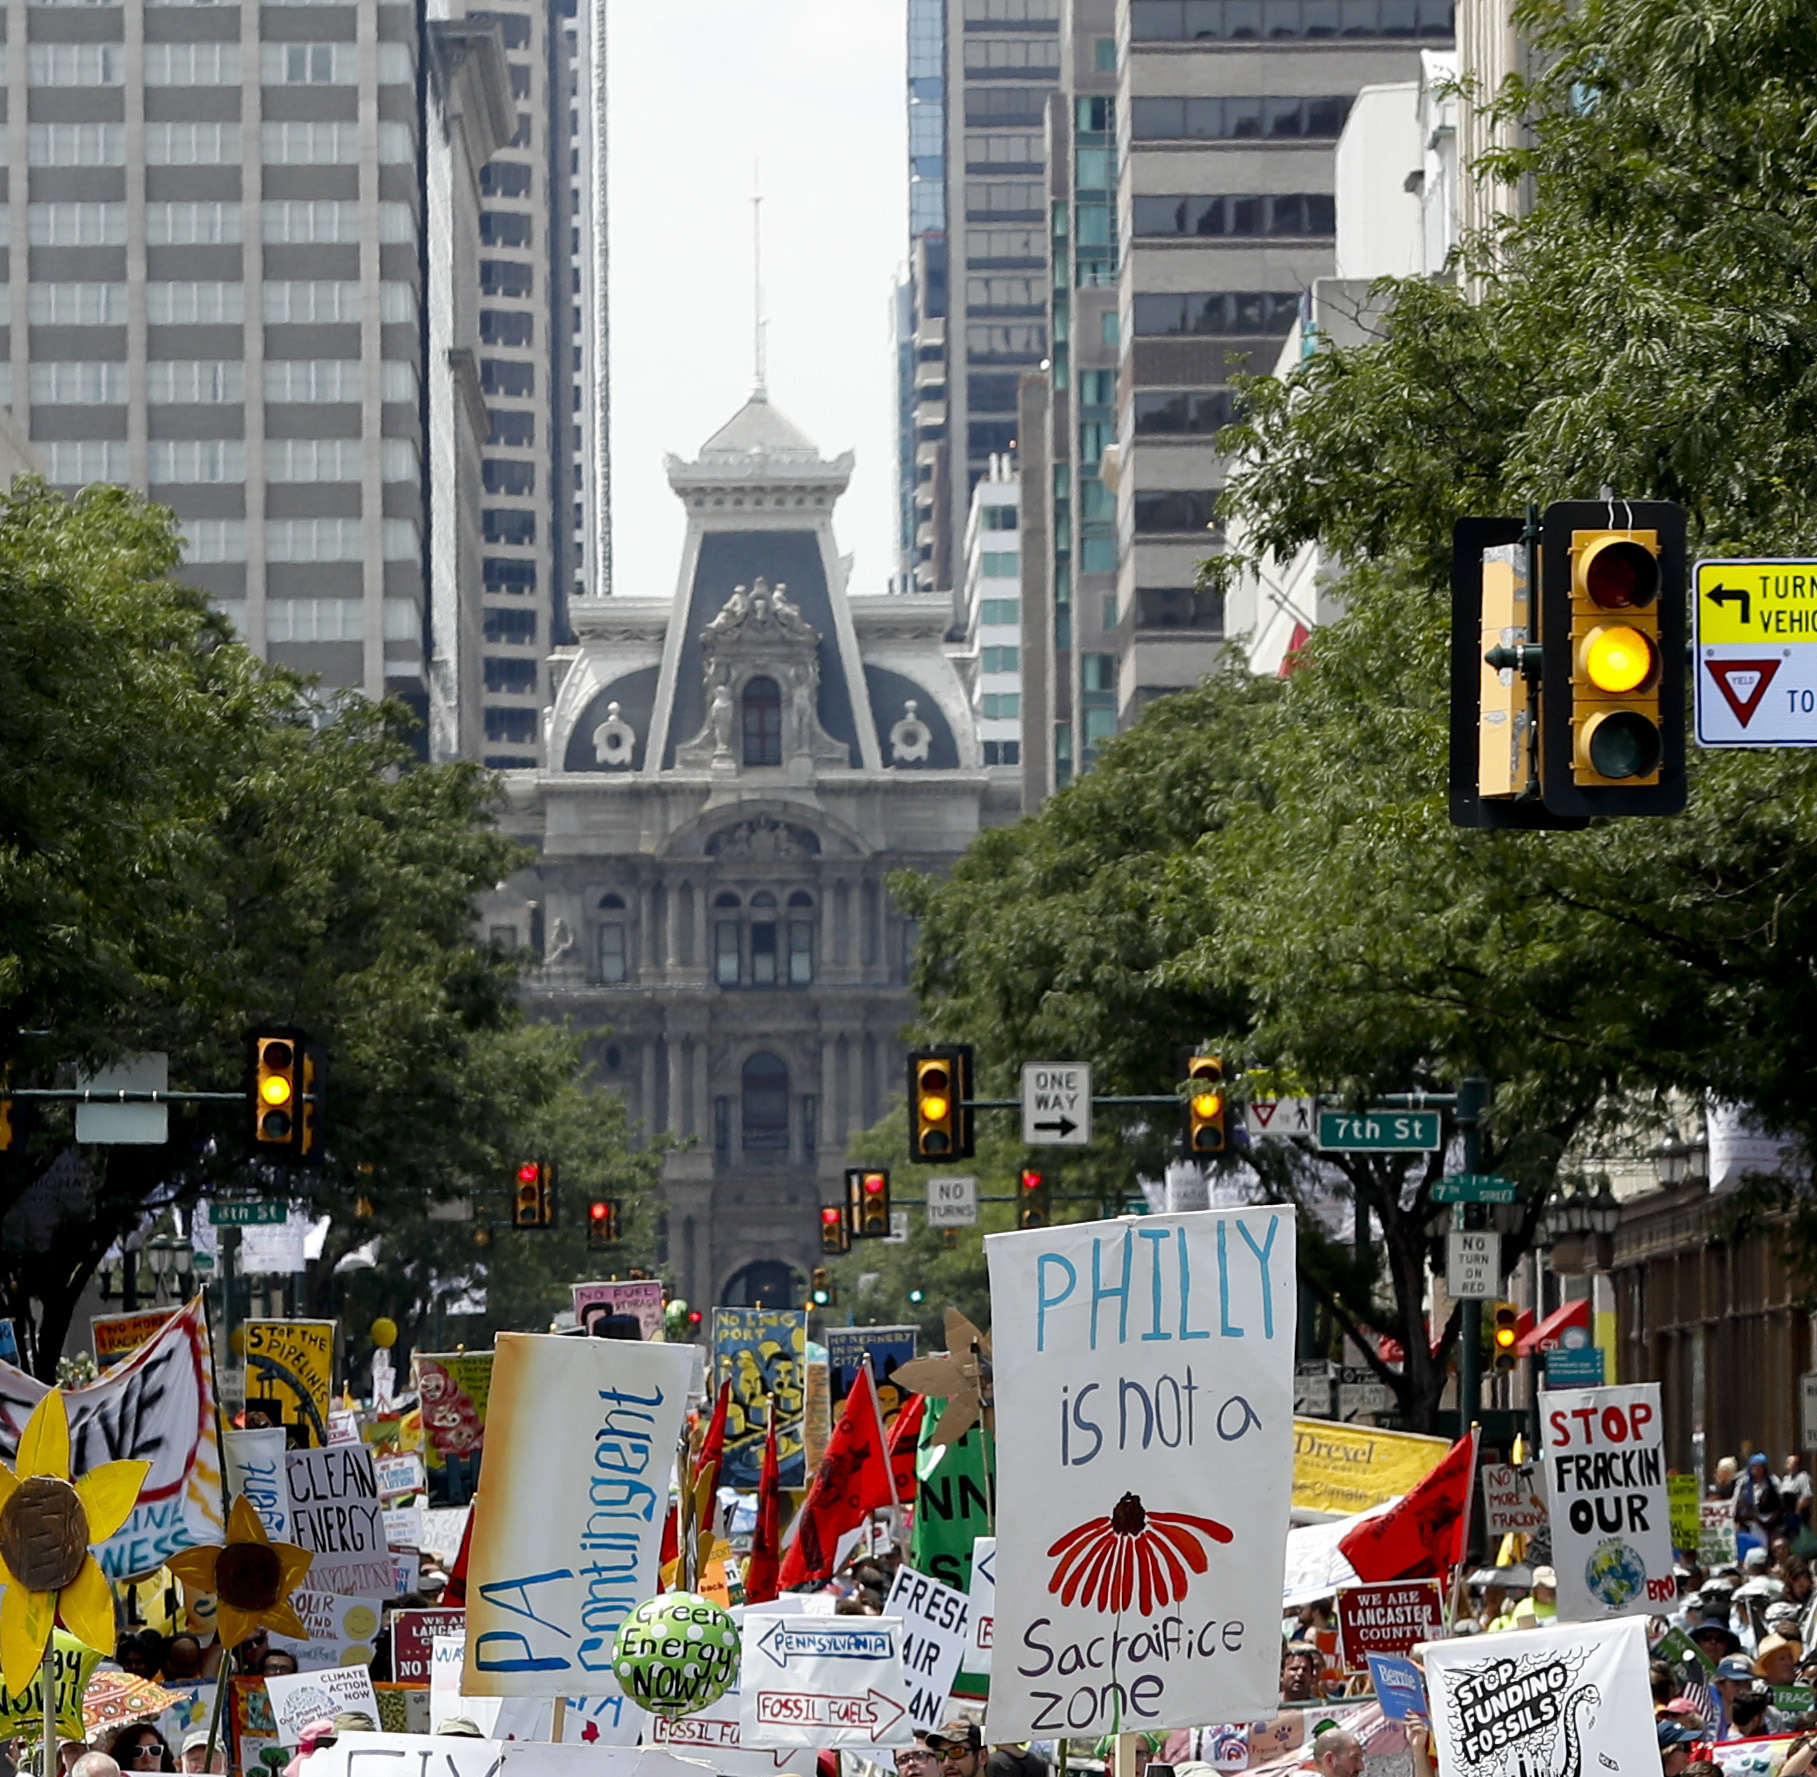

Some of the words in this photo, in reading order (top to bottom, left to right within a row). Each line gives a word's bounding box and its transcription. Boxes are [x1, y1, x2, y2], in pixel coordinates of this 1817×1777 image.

[1732, 676, 1755, 685] YIELD
[1787, 690, 1814, 712] TO
[1036, 1071, 1077, 1091] ONE
[1035, 1093, 1079, 1112] WAY
[1334, 1118, 1385, 1140] 7th
[1394, 1118, 1422, 1140] St
[939, 1184, 964, 1200] NO
[1458, 1254, 1489, 1266] TURN
[1036, 1214, 1279, 1352] PHILLY
[1465, 1268, 1482, 1279] ON
[1462, 1281, 1484, 1293] RED
[746, 1312, 796, 1327] LNG
[250, 1326, 294, 1348] STOP
[300, 1330, 327, 1352] THE
[719, 1329, 767, 1341] PORT
[268, 1339, 328, 1403] PIPELINES
[1119, 1365, 1199, 1450] not
[1216, 1395, 1262, 1440] a
[1550, 1403, 1652, 1447] STOP
[288, 1450, 377, 1502] CLEAN
[1489, 1493, 1523, 1506] MORE
[1492, 1511, 1548, 1526] FRACKING
[1569, 1494, 1650, 1535] OUR
[292, 1505, 378, 1553] ENERGY
[1357, 1594, 1384, 1607] WE
[1388, 1591, 1420, 1604] ARE
[1646, 1574, 1676, 1603] BRO
[636, 1603, 730, 1628] Green
[1348, 1604, 1432, 1627] LANCASTER
[775, 1633, 885, 1651] PENNSYLVANIA
[1360, 1625, 1423, 1641] COUNTY
[623, 1628, 733, 1682] Energy
[321, 1669, 365, 1683] CLIMATE
[329, 1680, 369, 1692] ACTION
[1458, 1661, 1514, 1705] STOP
[344, 1691, 370, 1701] NOW
[1030, 1674, 1165, 1731] zone
[1464, 1666, 1565, 1732] FUNDING
[1465, 1697, 1557, 1761] FOSSILS
